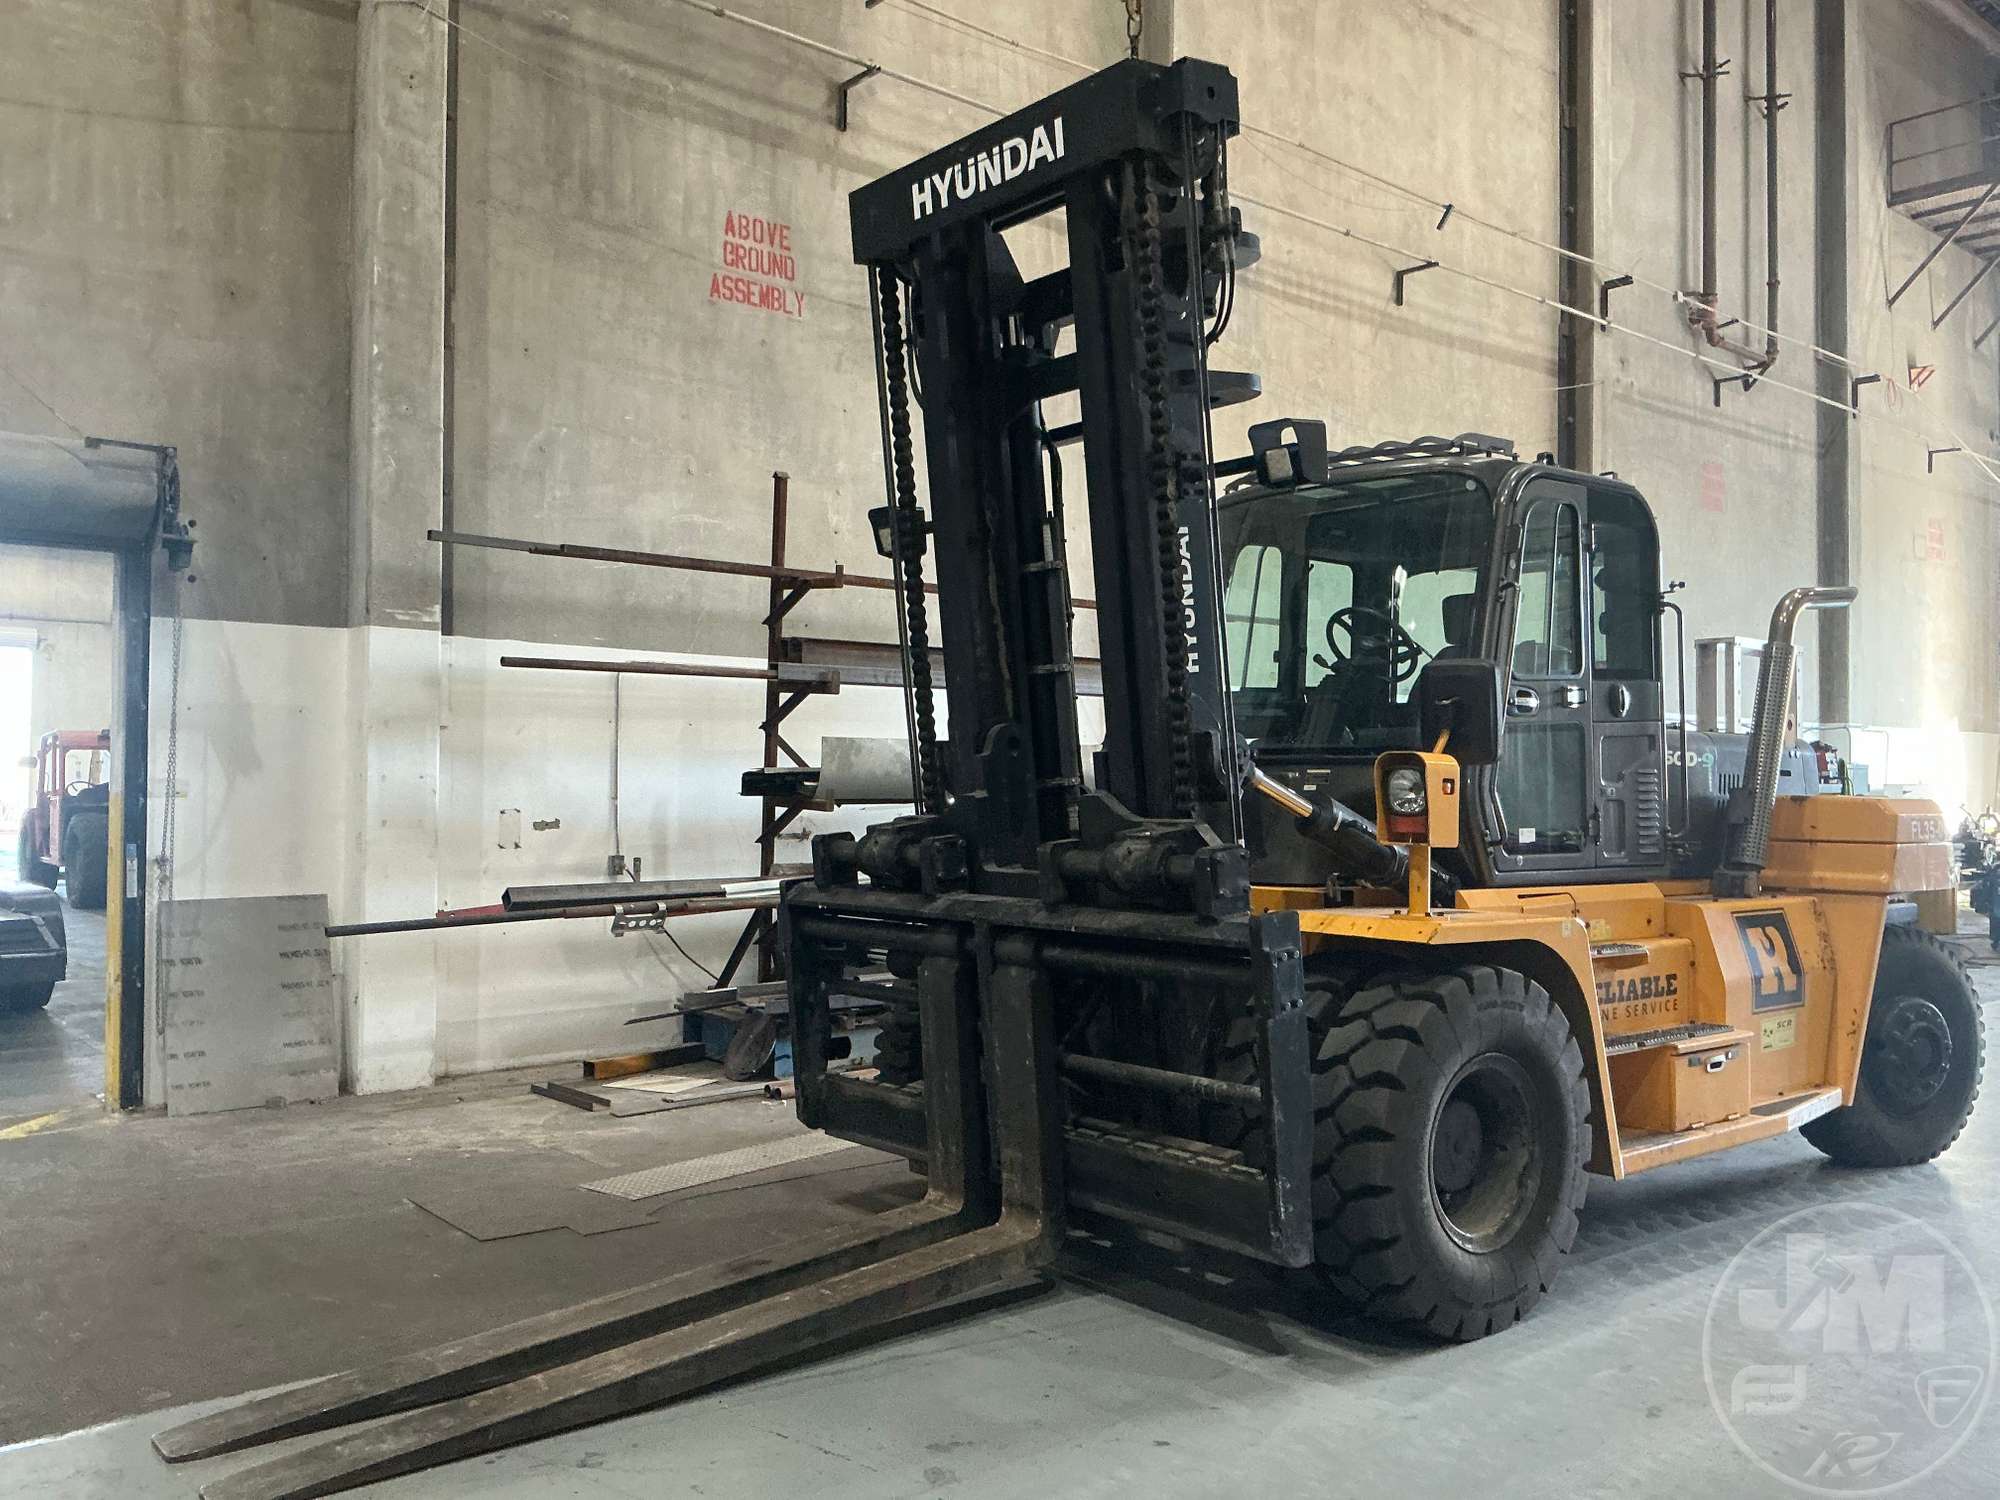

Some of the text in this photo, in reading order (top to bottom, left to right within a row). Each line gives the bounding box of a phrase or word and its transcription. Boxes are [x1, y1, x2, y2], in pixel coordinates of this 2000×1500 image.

[911, 116, 1066, 221] HYUNDAI
[724, 210, 792, 252] ABOVE
[723, 240, 795, 282] GROUND
[710, 272, 804, 318] ASSEMBLY
[1177, 526, 1200, 674] HYUNDAI
[1596, 973, 1678, 1005] ELIABLE
[1625, 998, 1678, 1018] SERVICE
